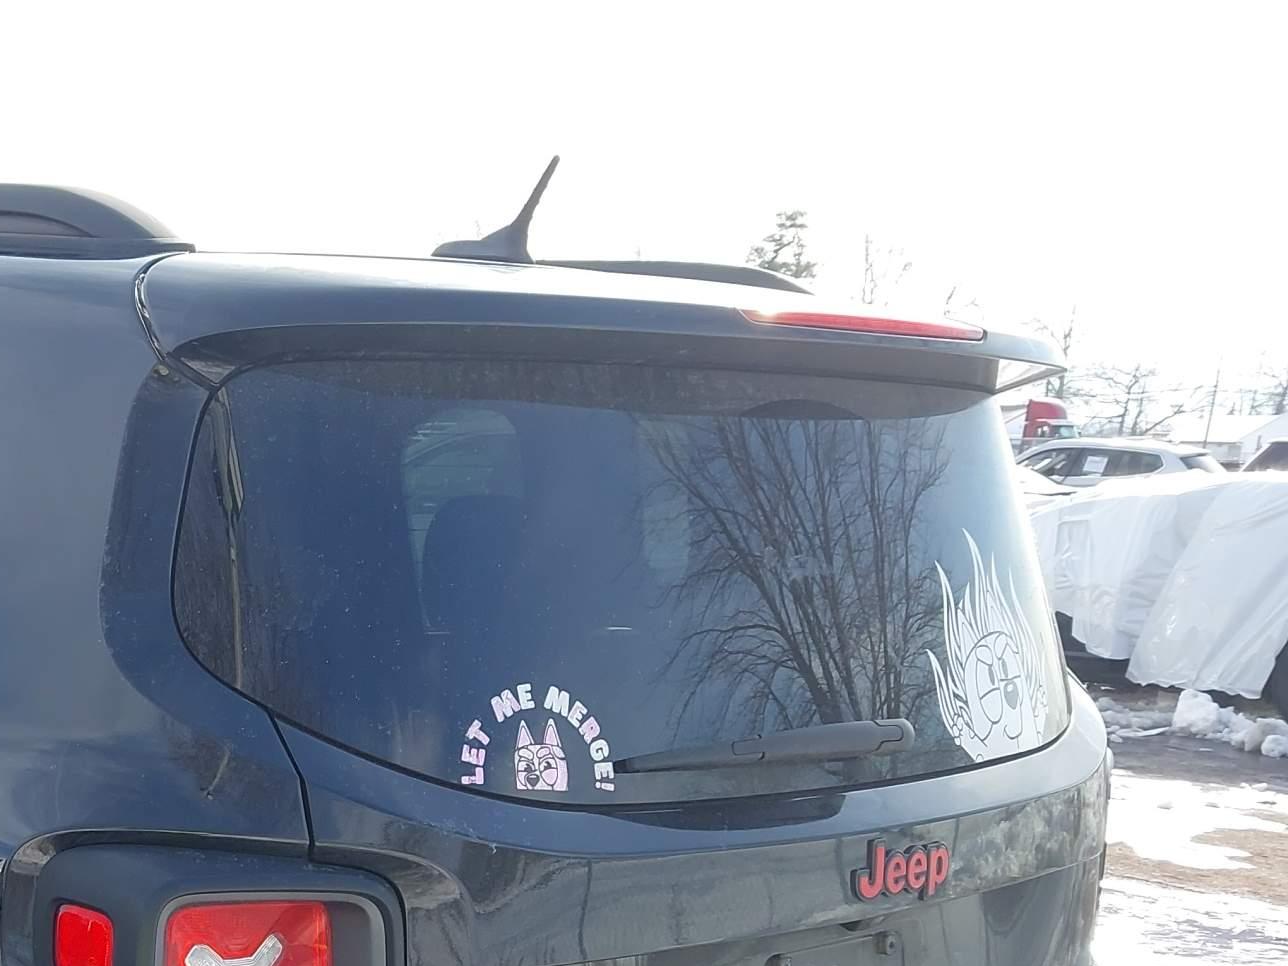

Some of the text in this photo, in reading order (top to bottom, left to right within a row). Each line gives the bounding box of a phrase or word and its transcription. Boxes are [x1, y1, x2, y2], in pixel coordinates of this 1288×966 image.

[461, 683, 615, 792] LET ME MERGE!
[854, 839, 950, 900] Jeep
